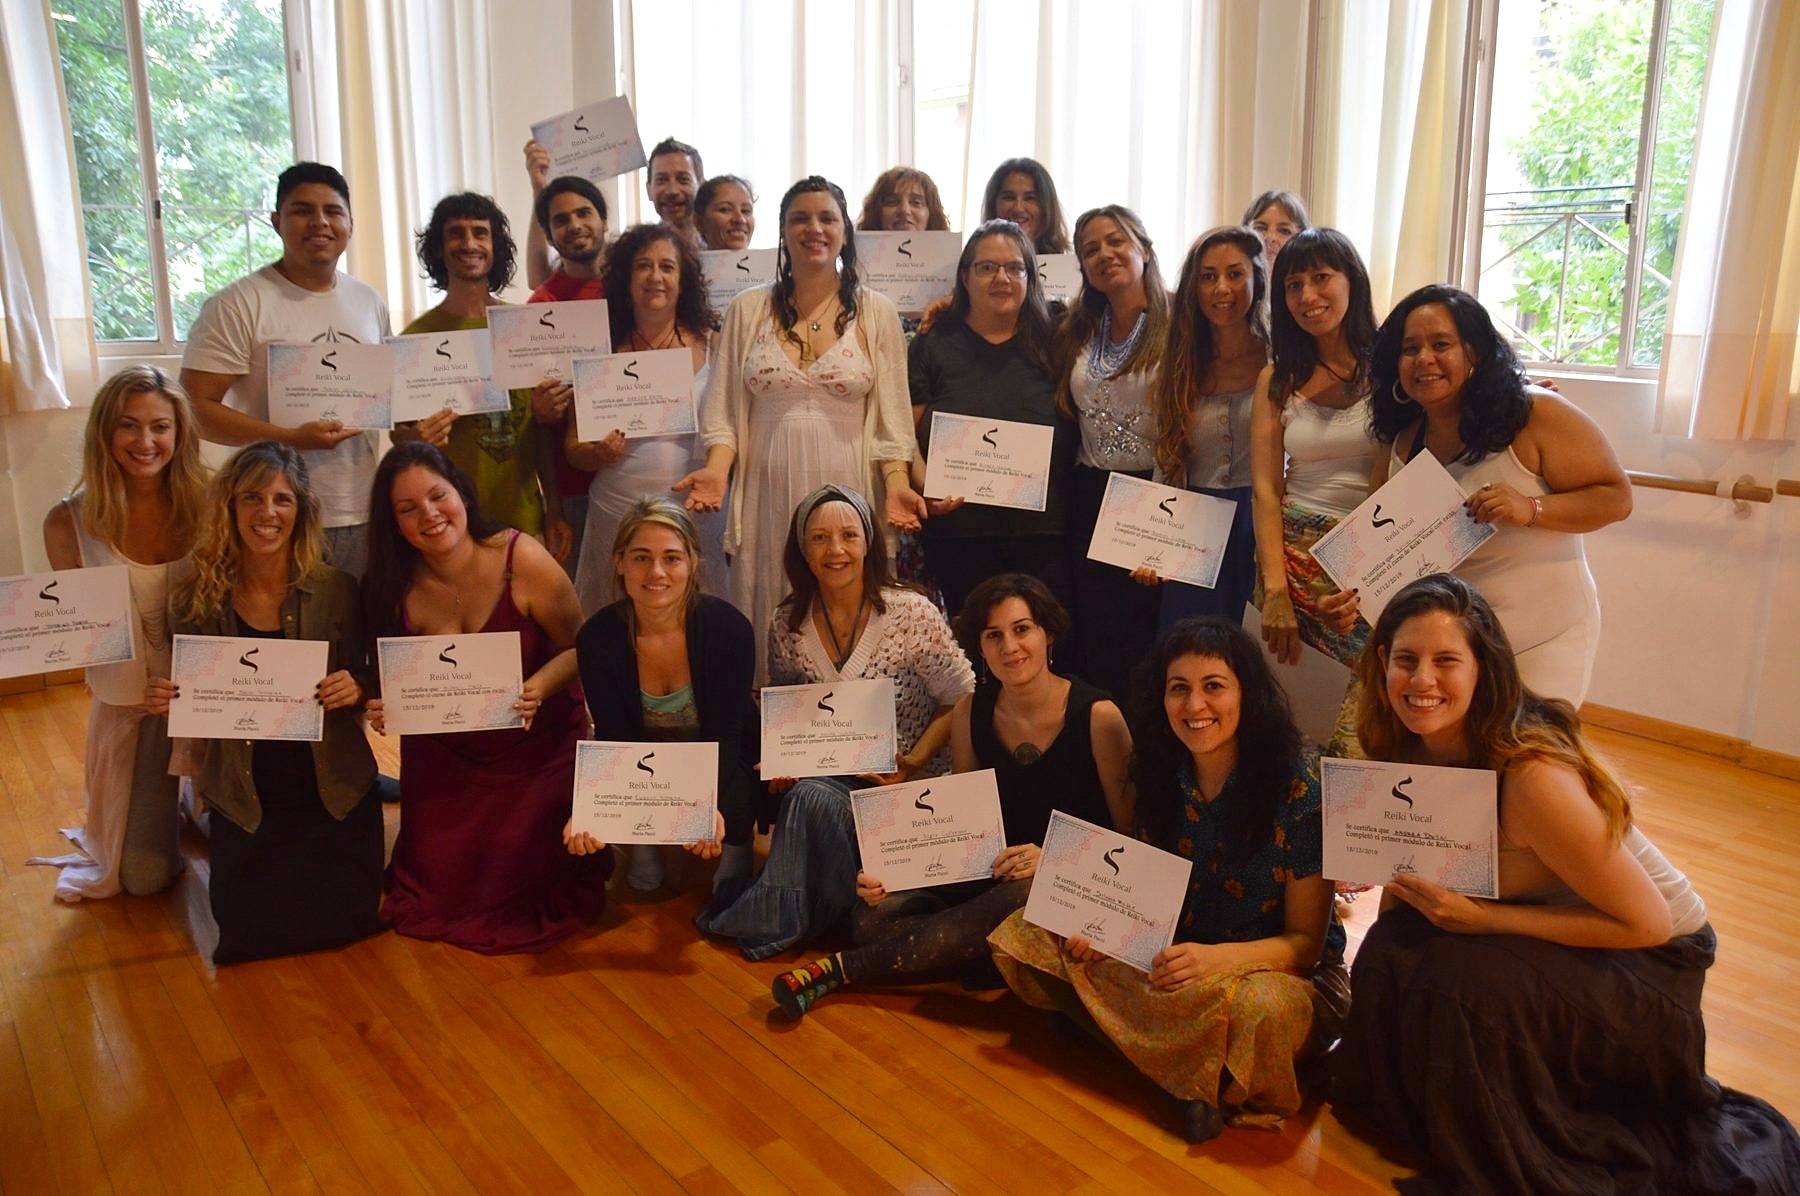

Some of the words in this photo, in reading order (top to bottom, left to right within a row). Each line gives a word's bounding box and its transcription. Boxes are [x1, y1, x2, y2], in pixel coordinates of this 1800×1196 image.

[571, 139, 588, 147] Reiki
[588, 132, 605, 141] Vocal
[1150, 515, 1166, 525] Reiki
[1168, 520, 1184, 530] Vocal
[1385, 529, 1399, 542] Reiki
[1399, 518, 1415, 531] Vocal
[34, 609, 54, 618] Reiki
[56, 607, 76, 616] Vocal
[912, 819, 932, 827] Reiki
[934, 816, 953, 824] Vocal
[1384, 811, 1406, 821] Reiki
[1410, 812, 1432, 823] Vocal
[1091, 873, 1110, 885] Reiki
[1113, 880, 1131, 893] Vocal
